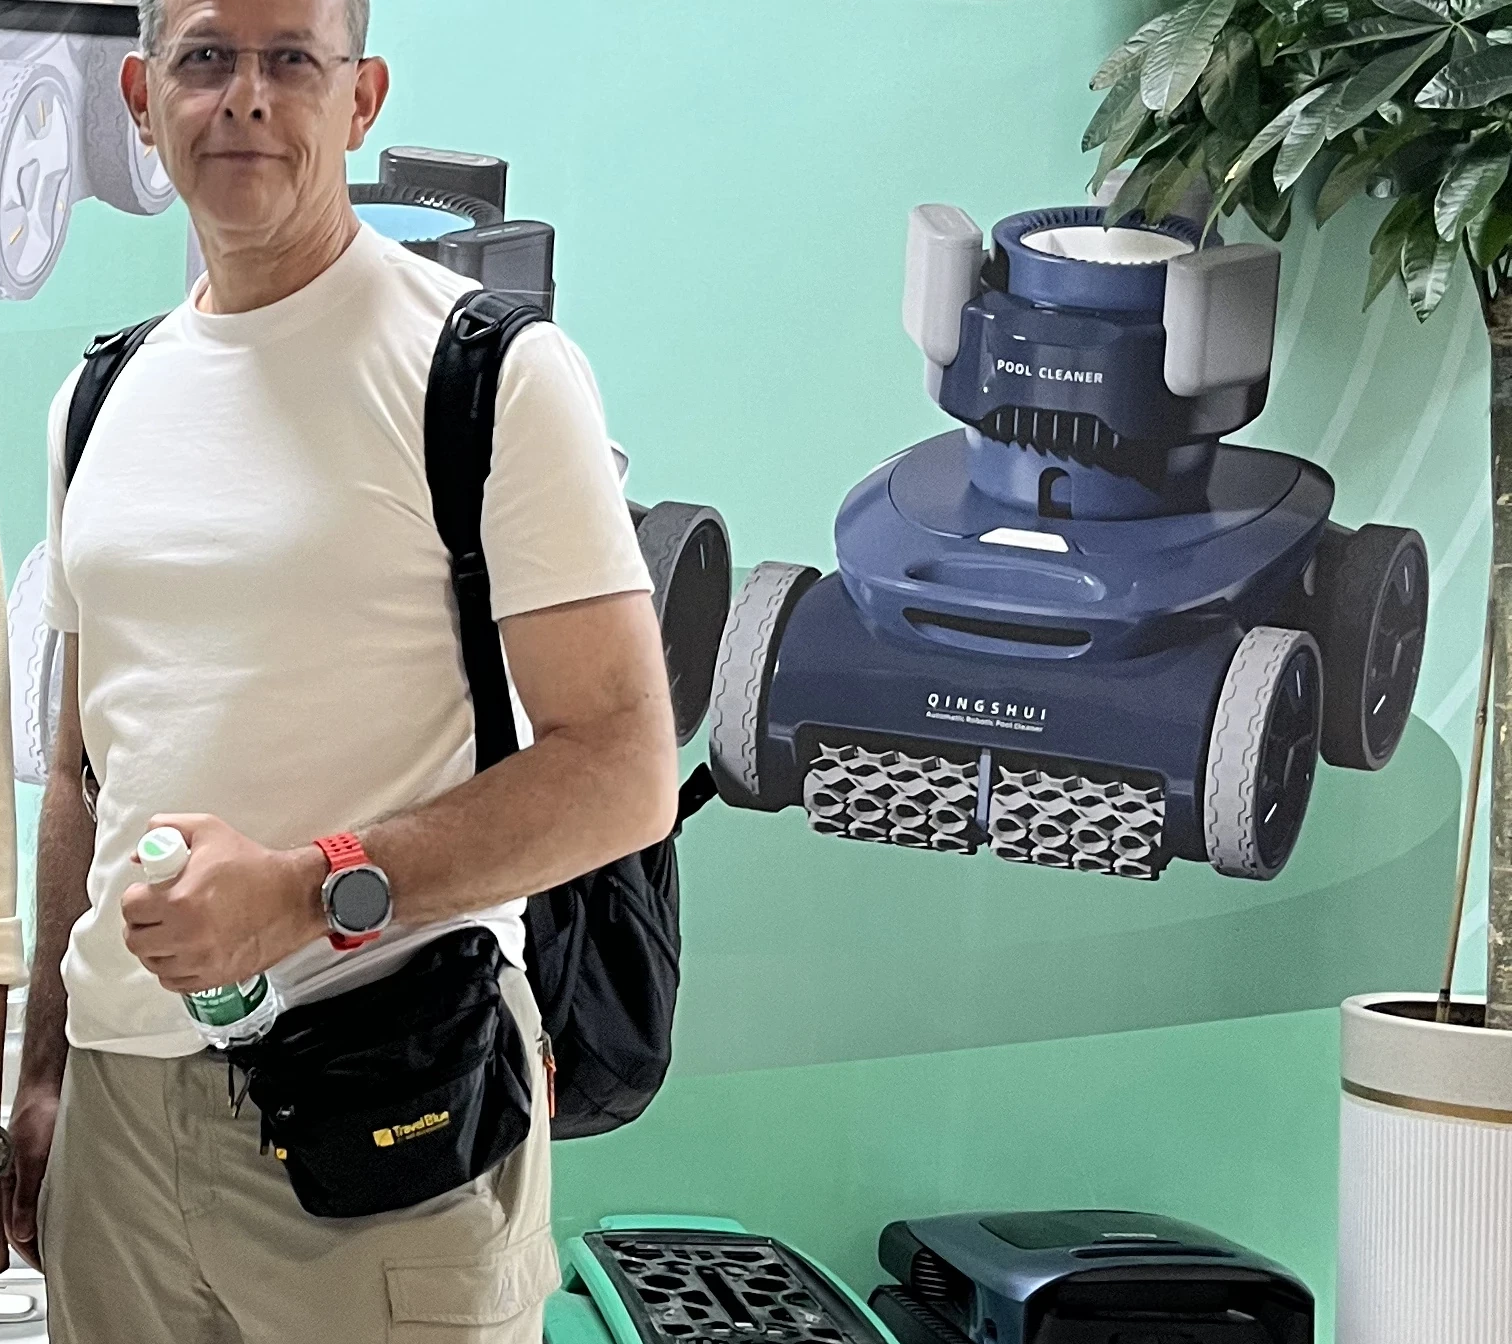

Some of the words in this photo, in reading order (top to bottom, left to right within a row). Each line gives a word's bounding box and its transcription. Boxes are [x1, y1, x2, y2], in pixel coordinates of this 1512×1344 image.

[996, 359, 1032, 377] POOL
[1038, 367, 1103, 384] CLEANER
[927, 693, 1046, 720] QINGSHUI
